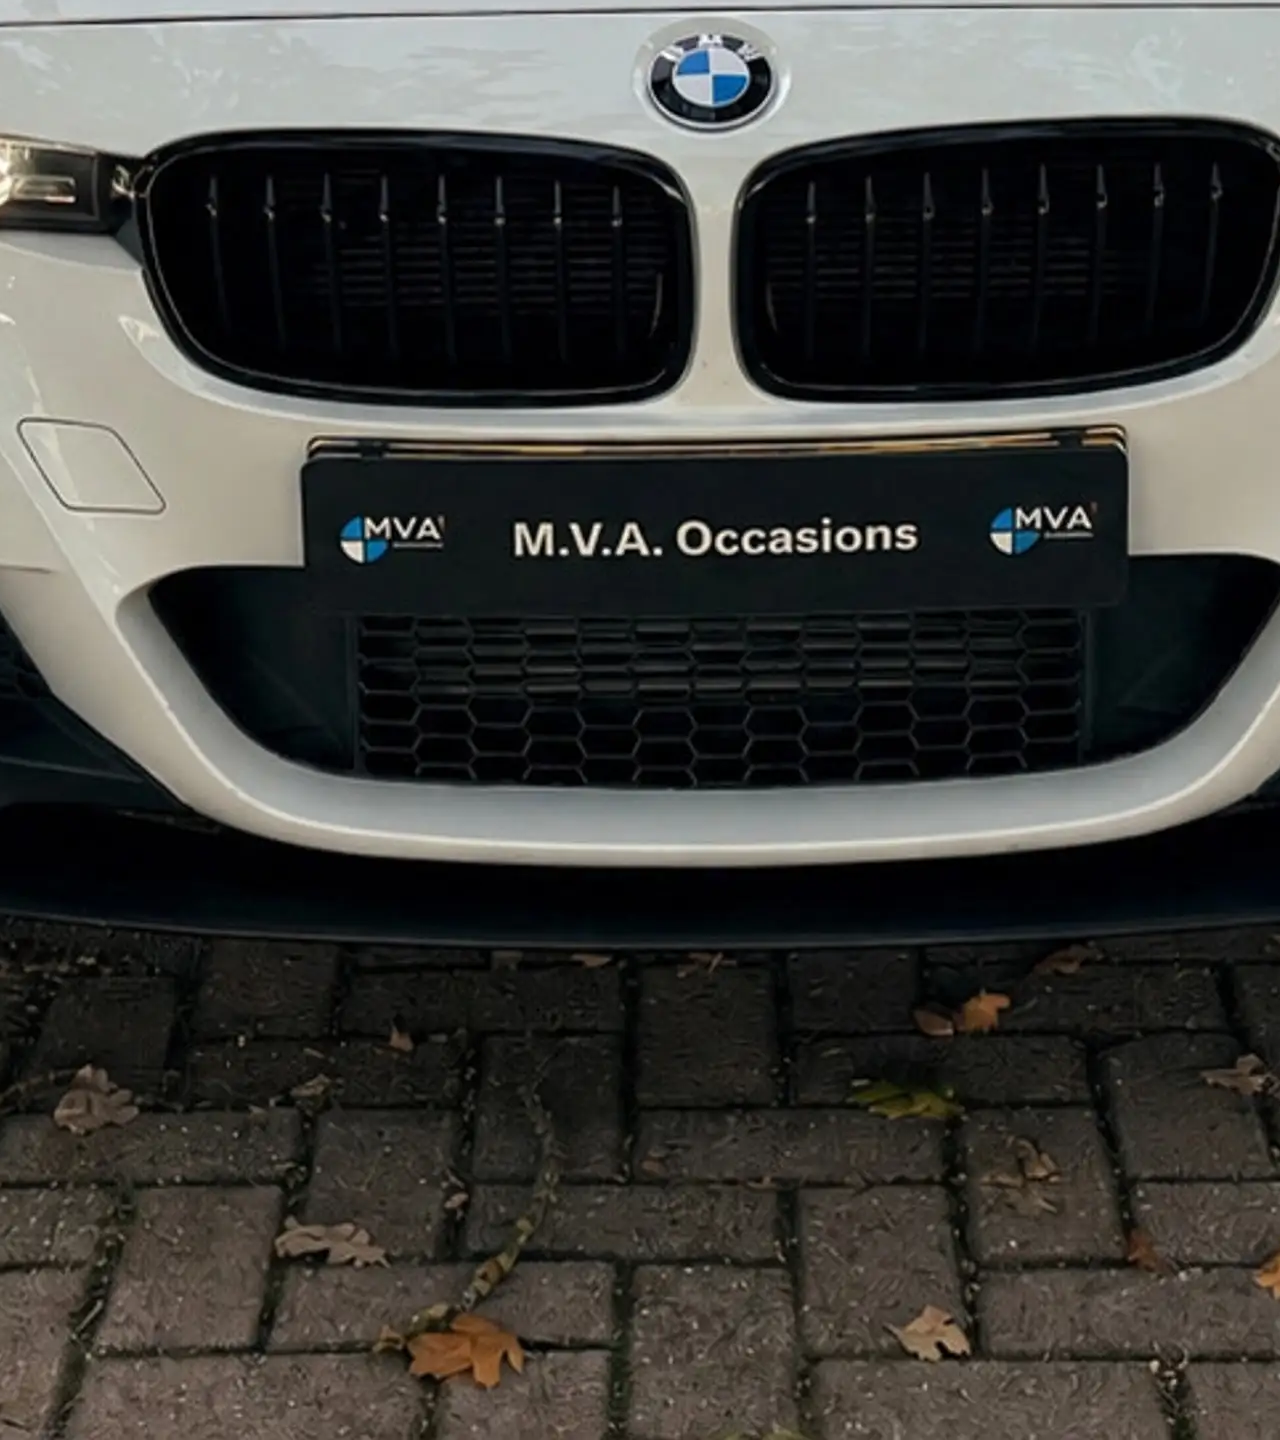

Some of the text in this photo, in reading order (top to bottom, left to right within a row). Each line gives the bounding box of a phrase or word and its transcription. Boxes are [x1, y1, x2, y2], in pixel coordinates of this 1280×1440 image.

[364, 516, 441, 540] MVA
[1015, 505, 1092, 530] MVA
[513, 517, 920, 557] M.V.A. Occasions
